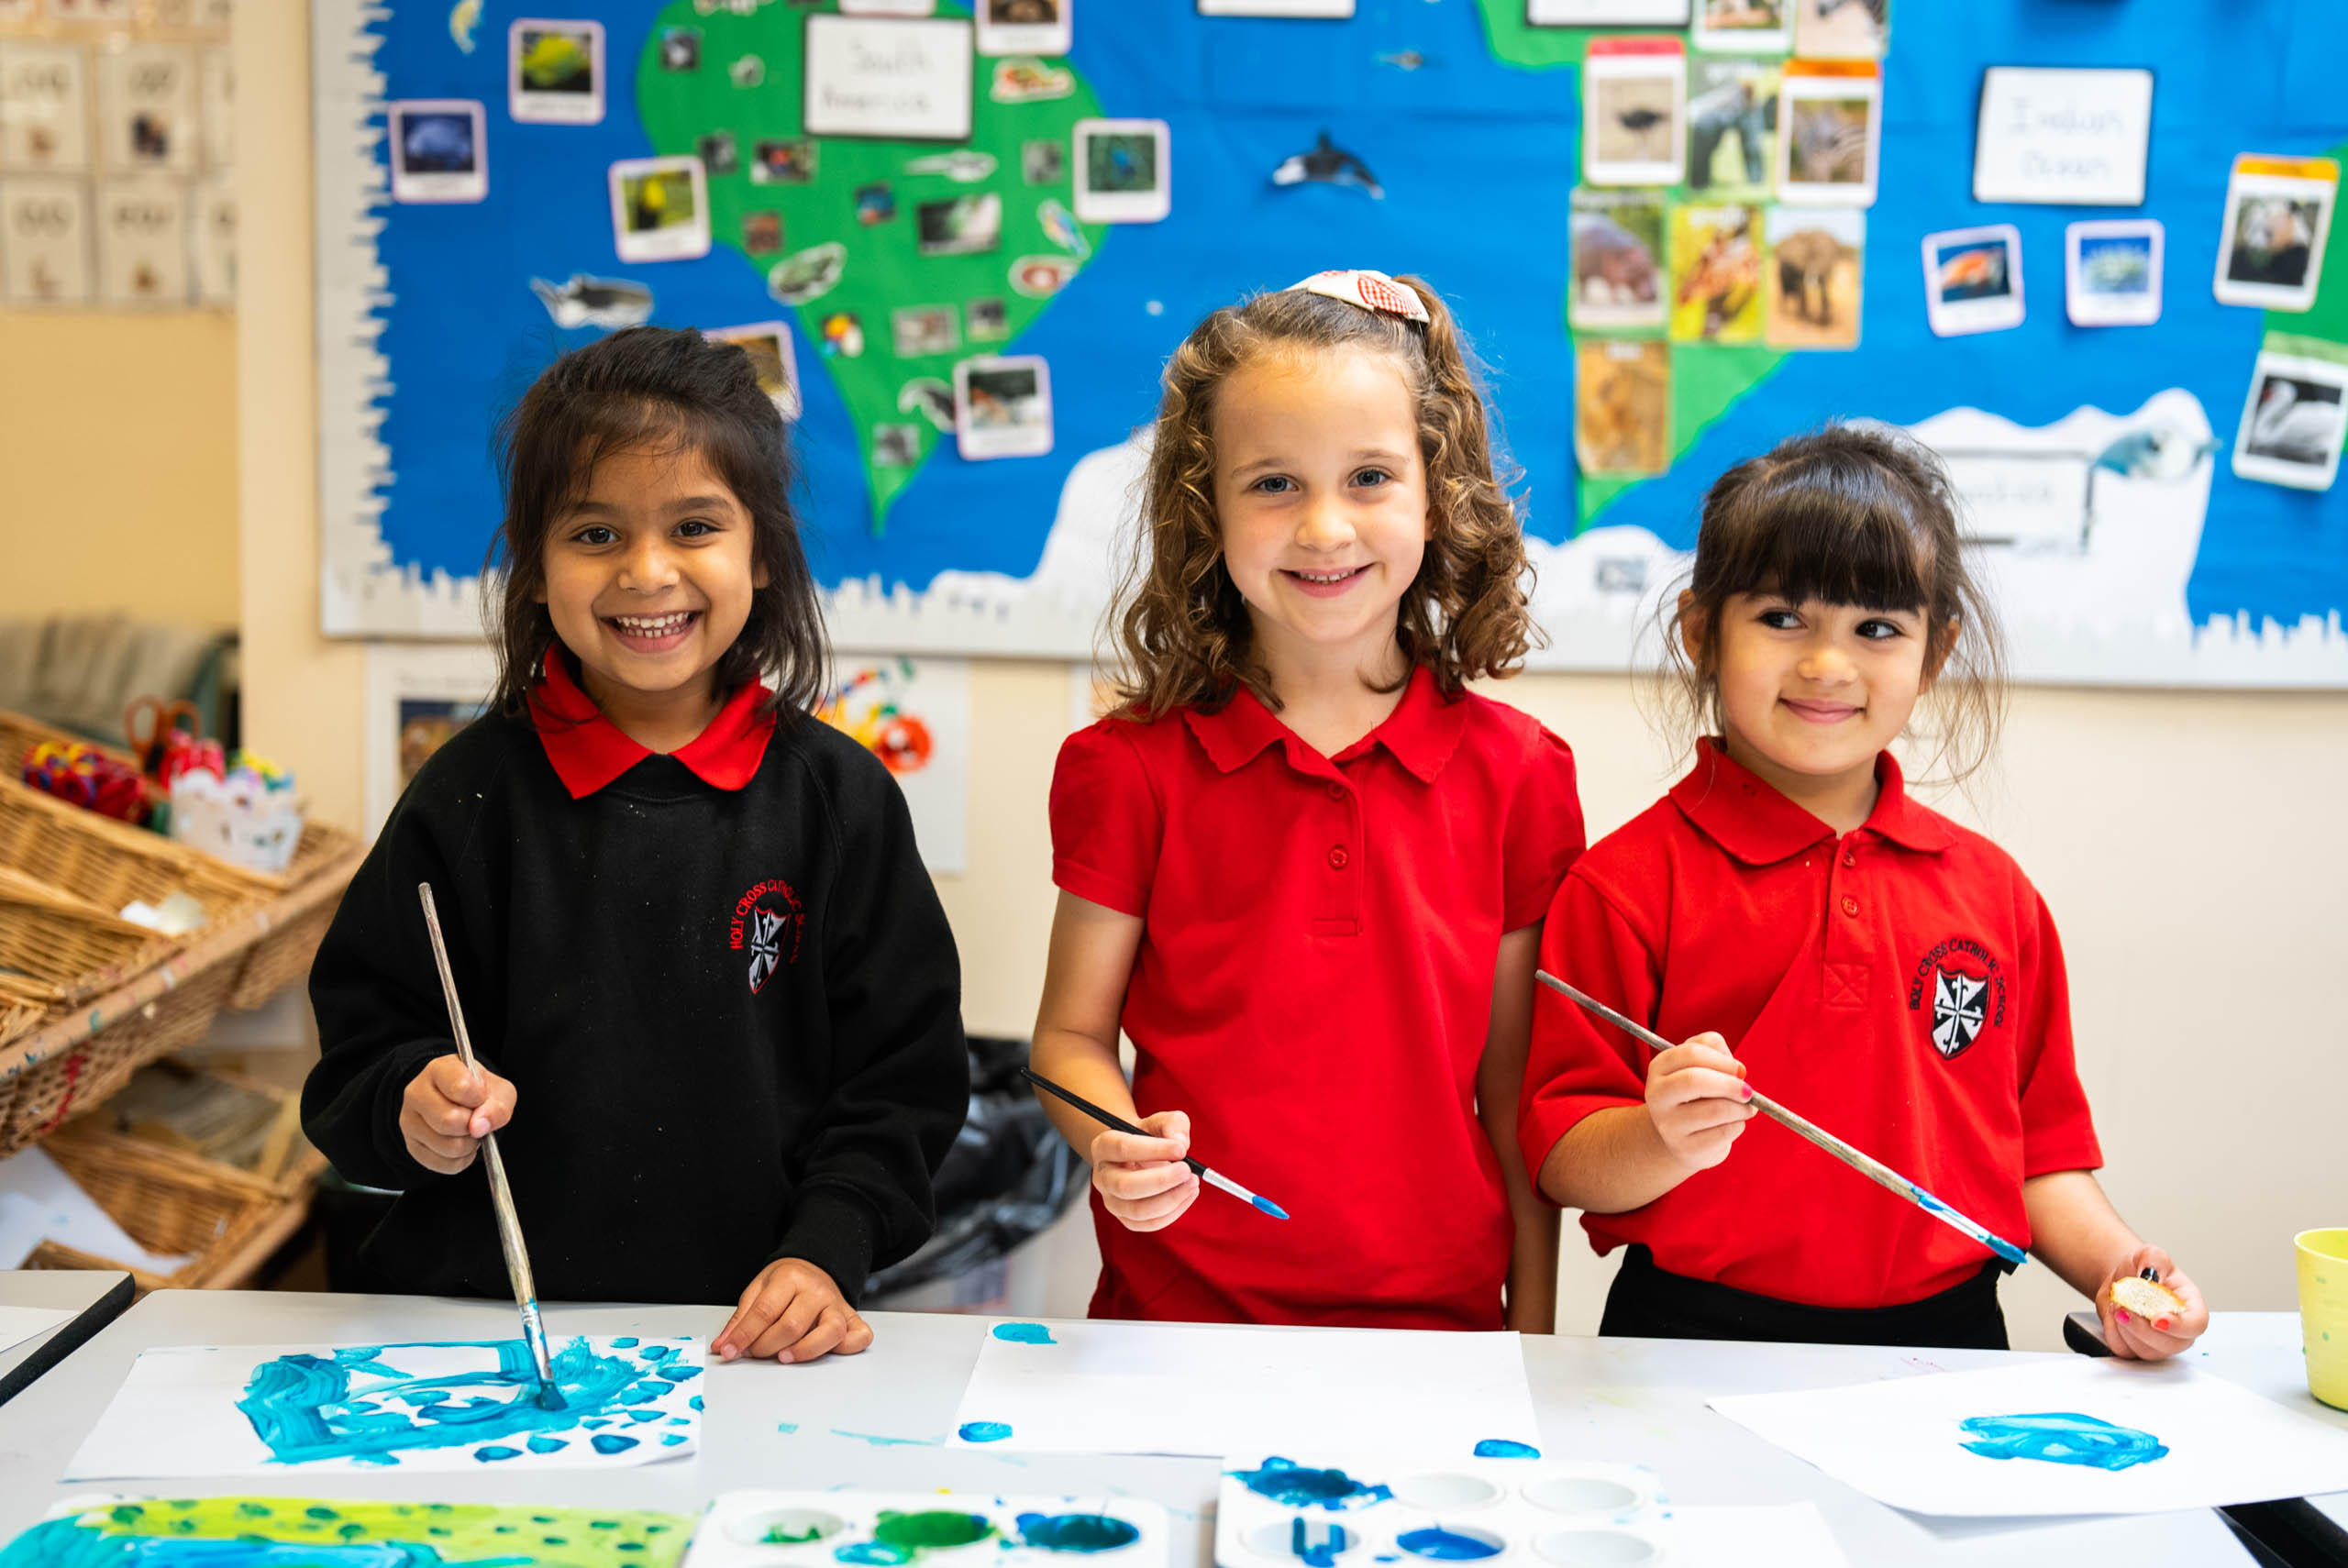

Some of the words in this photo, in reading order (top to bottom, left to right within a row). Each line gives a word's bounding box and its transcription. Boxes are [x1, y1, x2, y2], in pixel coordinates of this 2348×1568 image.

[728, 916, 744, 950] HOLY
[736, 881, 767, 916] CROSS
[1918, 942, 1948, 976] CROSS
[1949, 938, 1999, 974] CATHOLIC
